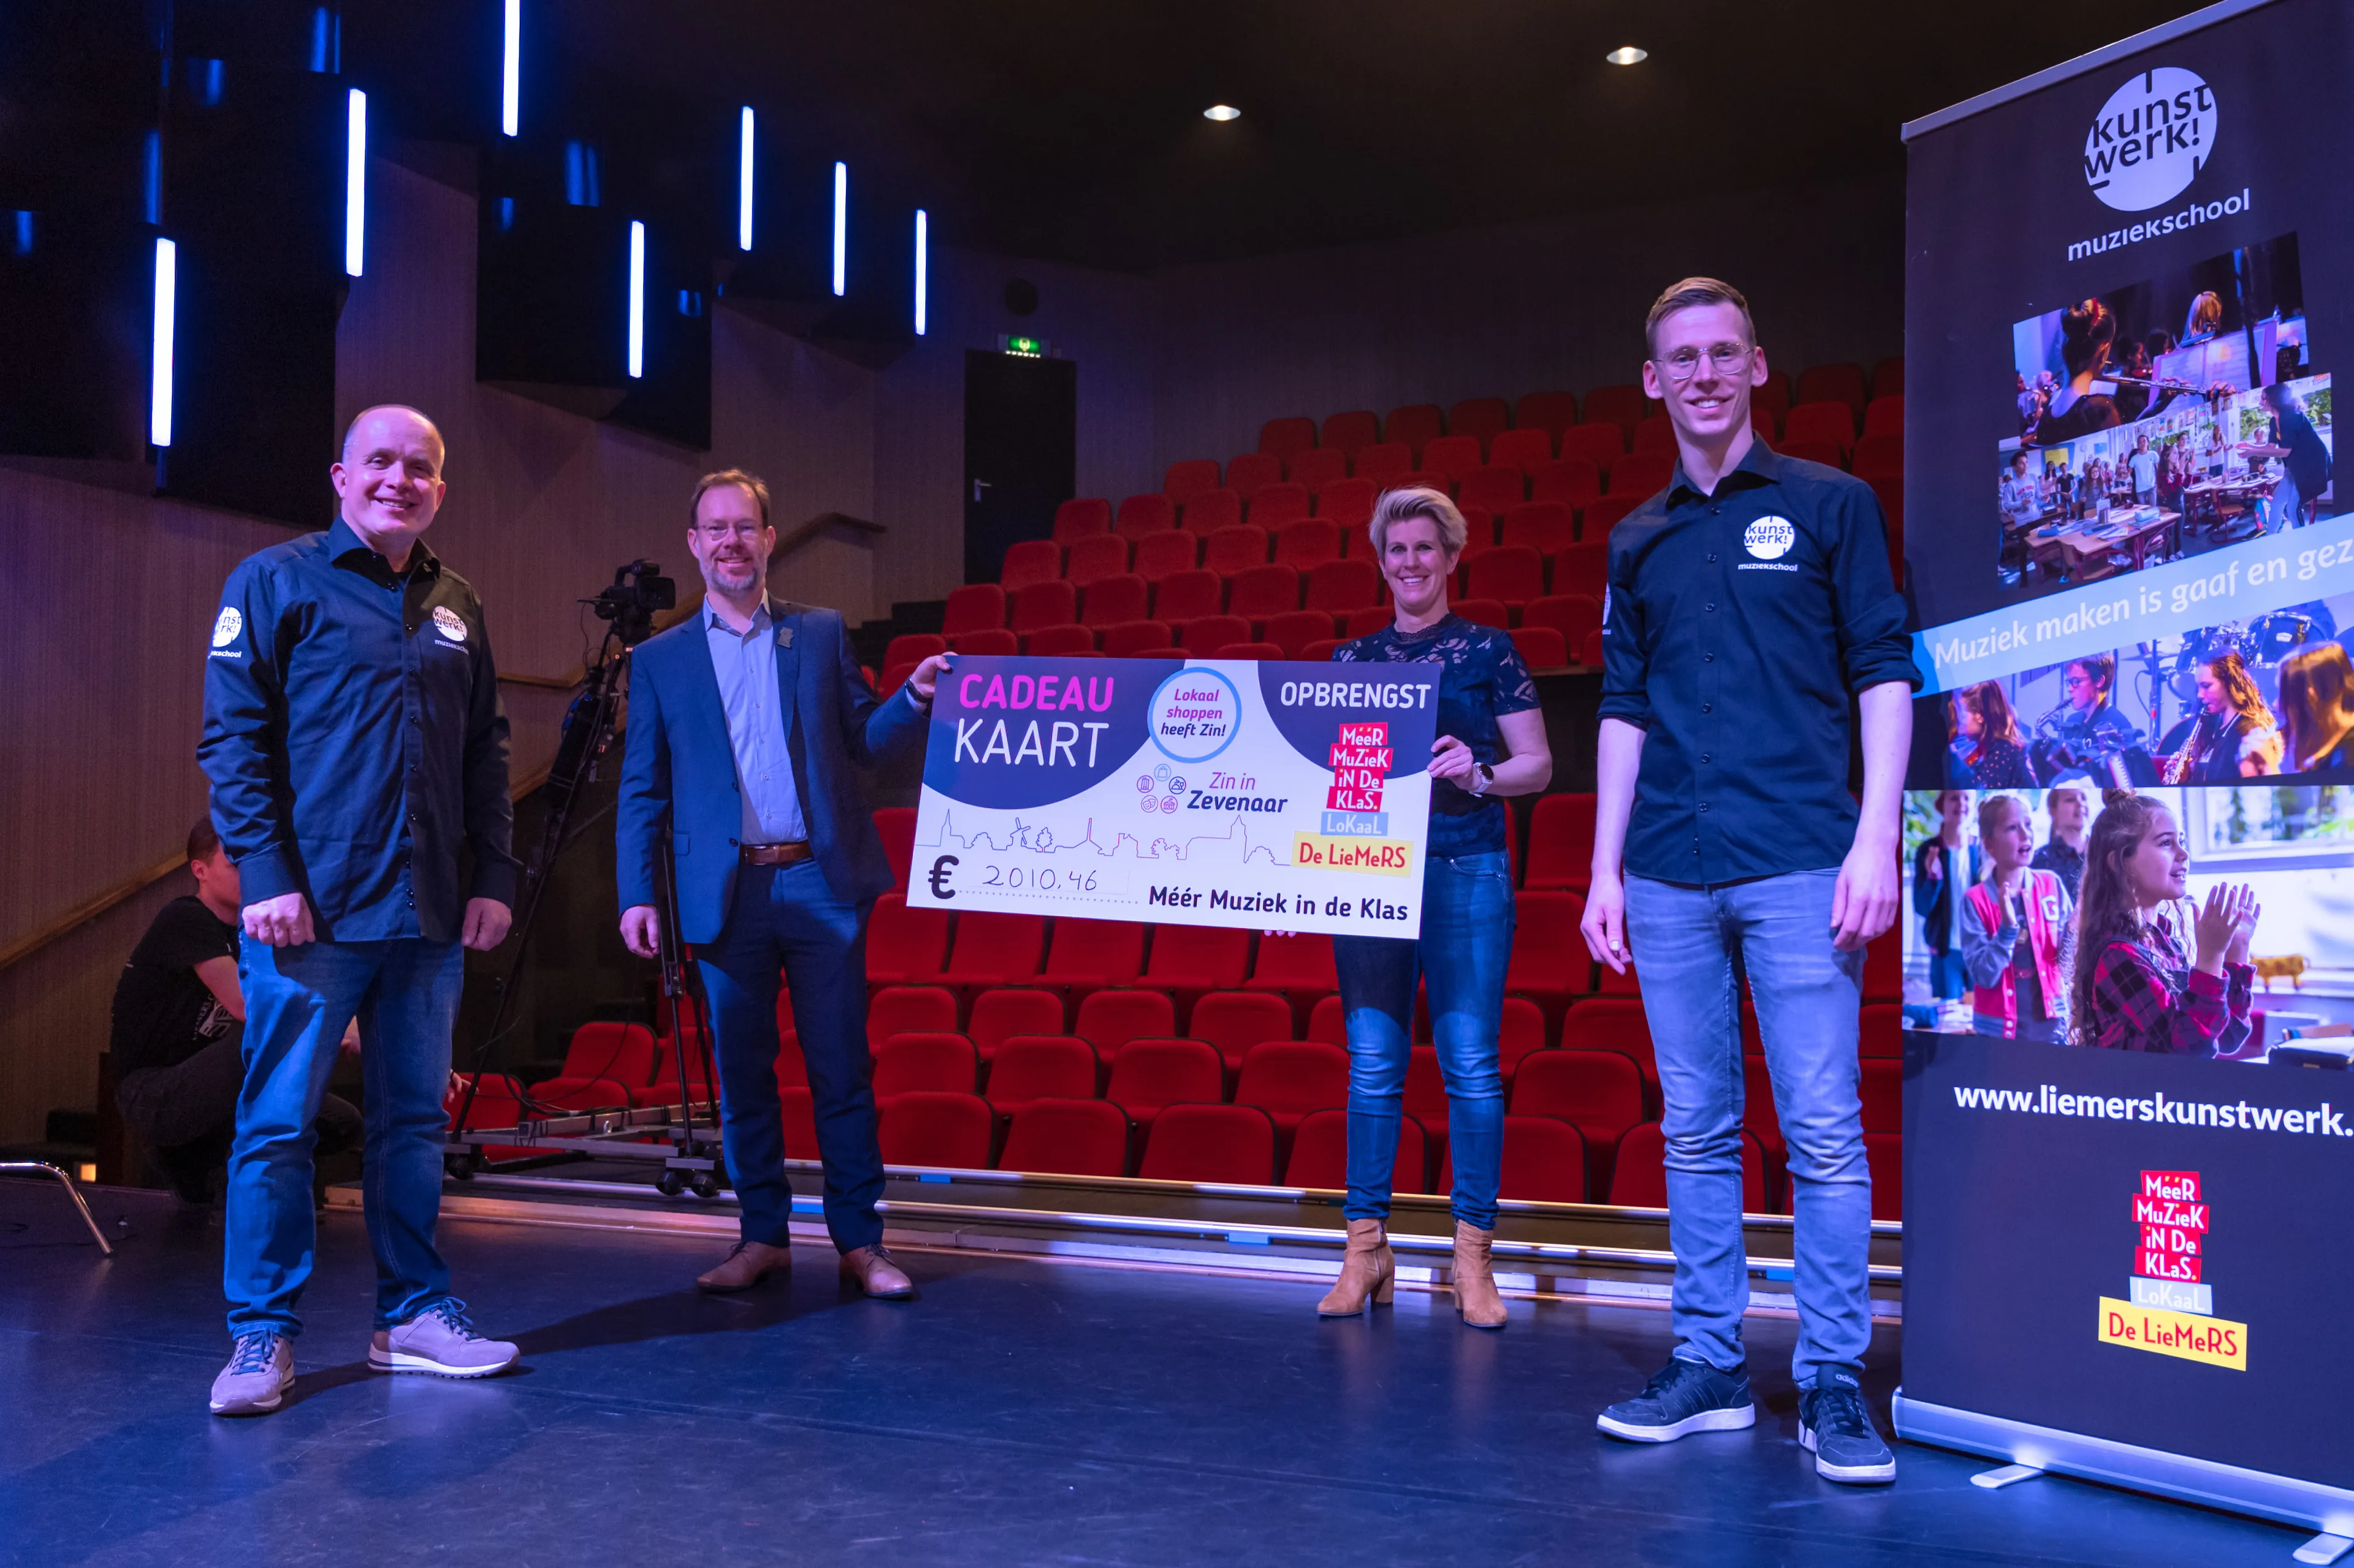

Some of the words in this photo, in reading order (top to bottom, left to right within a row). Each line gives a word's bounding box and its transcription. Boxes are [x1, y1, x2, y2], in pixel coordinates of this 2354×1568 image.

[2093, 83, 2212, 149] kunst
[2085, 117, 2201, 179] werk!
[2068, 188, 2250, 262] muziekschool
[1744, 534, 1787, 544] werk!
[1748, 525, 1792, 535] kunst
[1737, 562, 1798, 571] muziekschool
[434, 610, 464, 626] kunst
[1935, 620, 2028, 669] Muziek
[2036, 602, 2130, 642] maken
[2140, 586, 2162, 615] is
[2171, 560, 2239, 613] gaaf
[2247, 557, 2287, 585] en
[433, 618, 463, 632] werk!
[960, 674, 1114, 712] CADEAU
[1174, 688, 1219, 701] Lokaal
[1281, 682, 1431, 709] OPBRENGST
[1167, 706, 1222, 721] shoppen
[1161, 722, 1196, 739] heeft
[1199, 723, 1226, 736] Zin!
[954, 718, 1109, 768] KAART
[1209, 772, 1235, 790] Zin
[1240, 773, 1255, 790] in
[1359, 769, 1379, 788] De
[1187, 790, 1288, 813] Zevenaar
[1299, 842, 1322, 864] De
[1149, 885, 1202, 908] Méér
[1210, 889, 1287, 913] Muziek
[1295, 894, 1316, 915] in
[1325, 896, 1351, 917] de
[1360, 897, 1408, 921] Klas
[1954, 1084, 2353, 1136] www.liemerskunstwerk.
[2171, 1229, 2196, 1254] De
[2109, 1312, 2136, 1340] De
